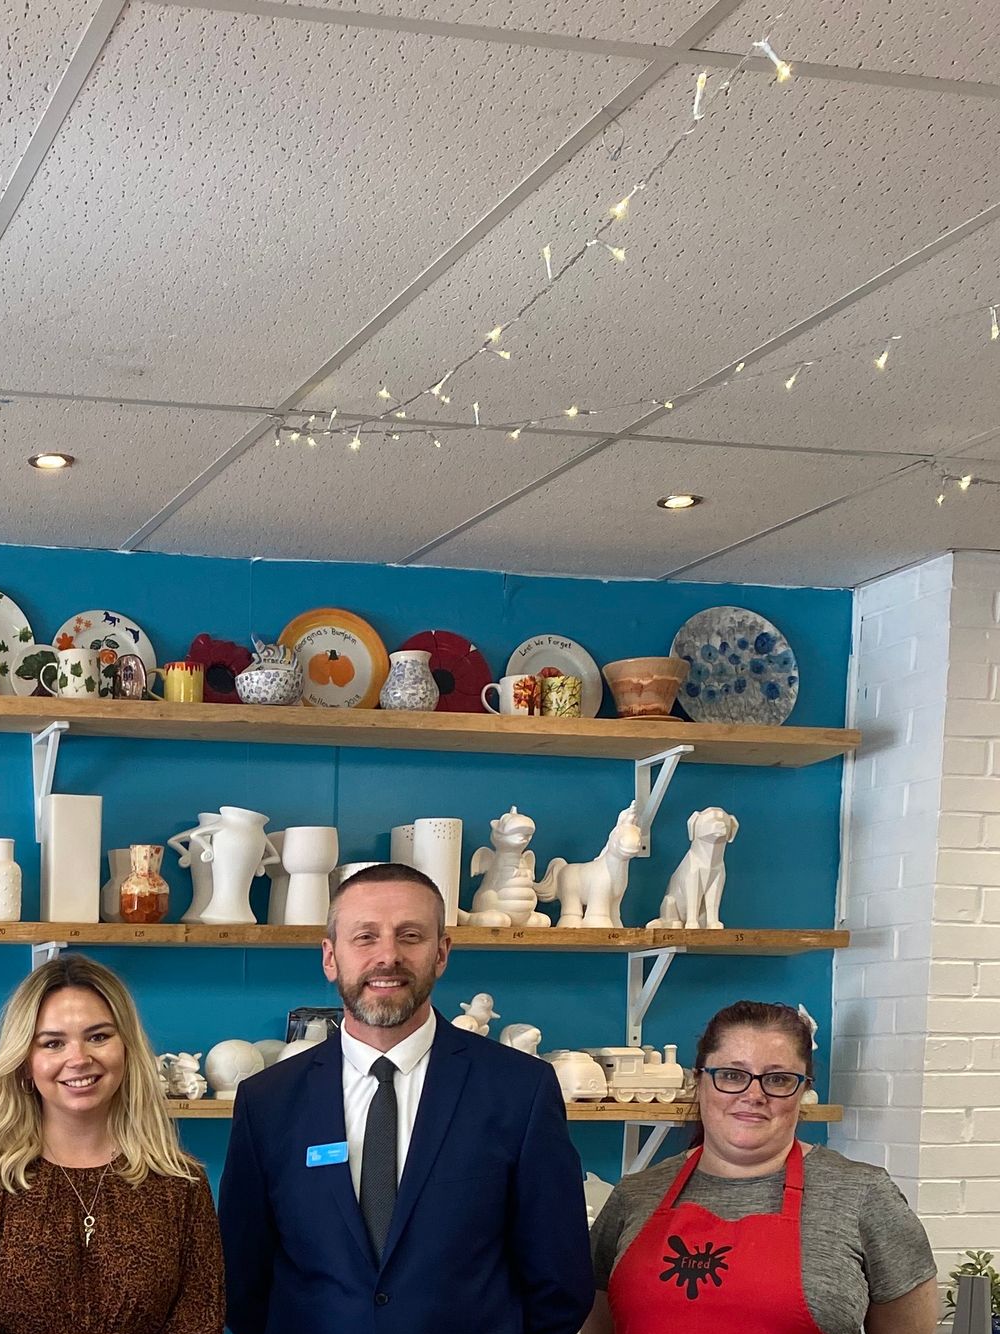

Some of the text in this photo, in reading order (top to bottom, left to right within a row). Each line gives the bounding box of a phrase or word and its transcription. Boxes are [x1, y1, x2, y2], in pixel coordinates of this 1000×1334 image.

[518, 644, 533, 657] Lest
[547, 636, 572, 649] Forget
[681, 1257, 711, 1269] Fired
